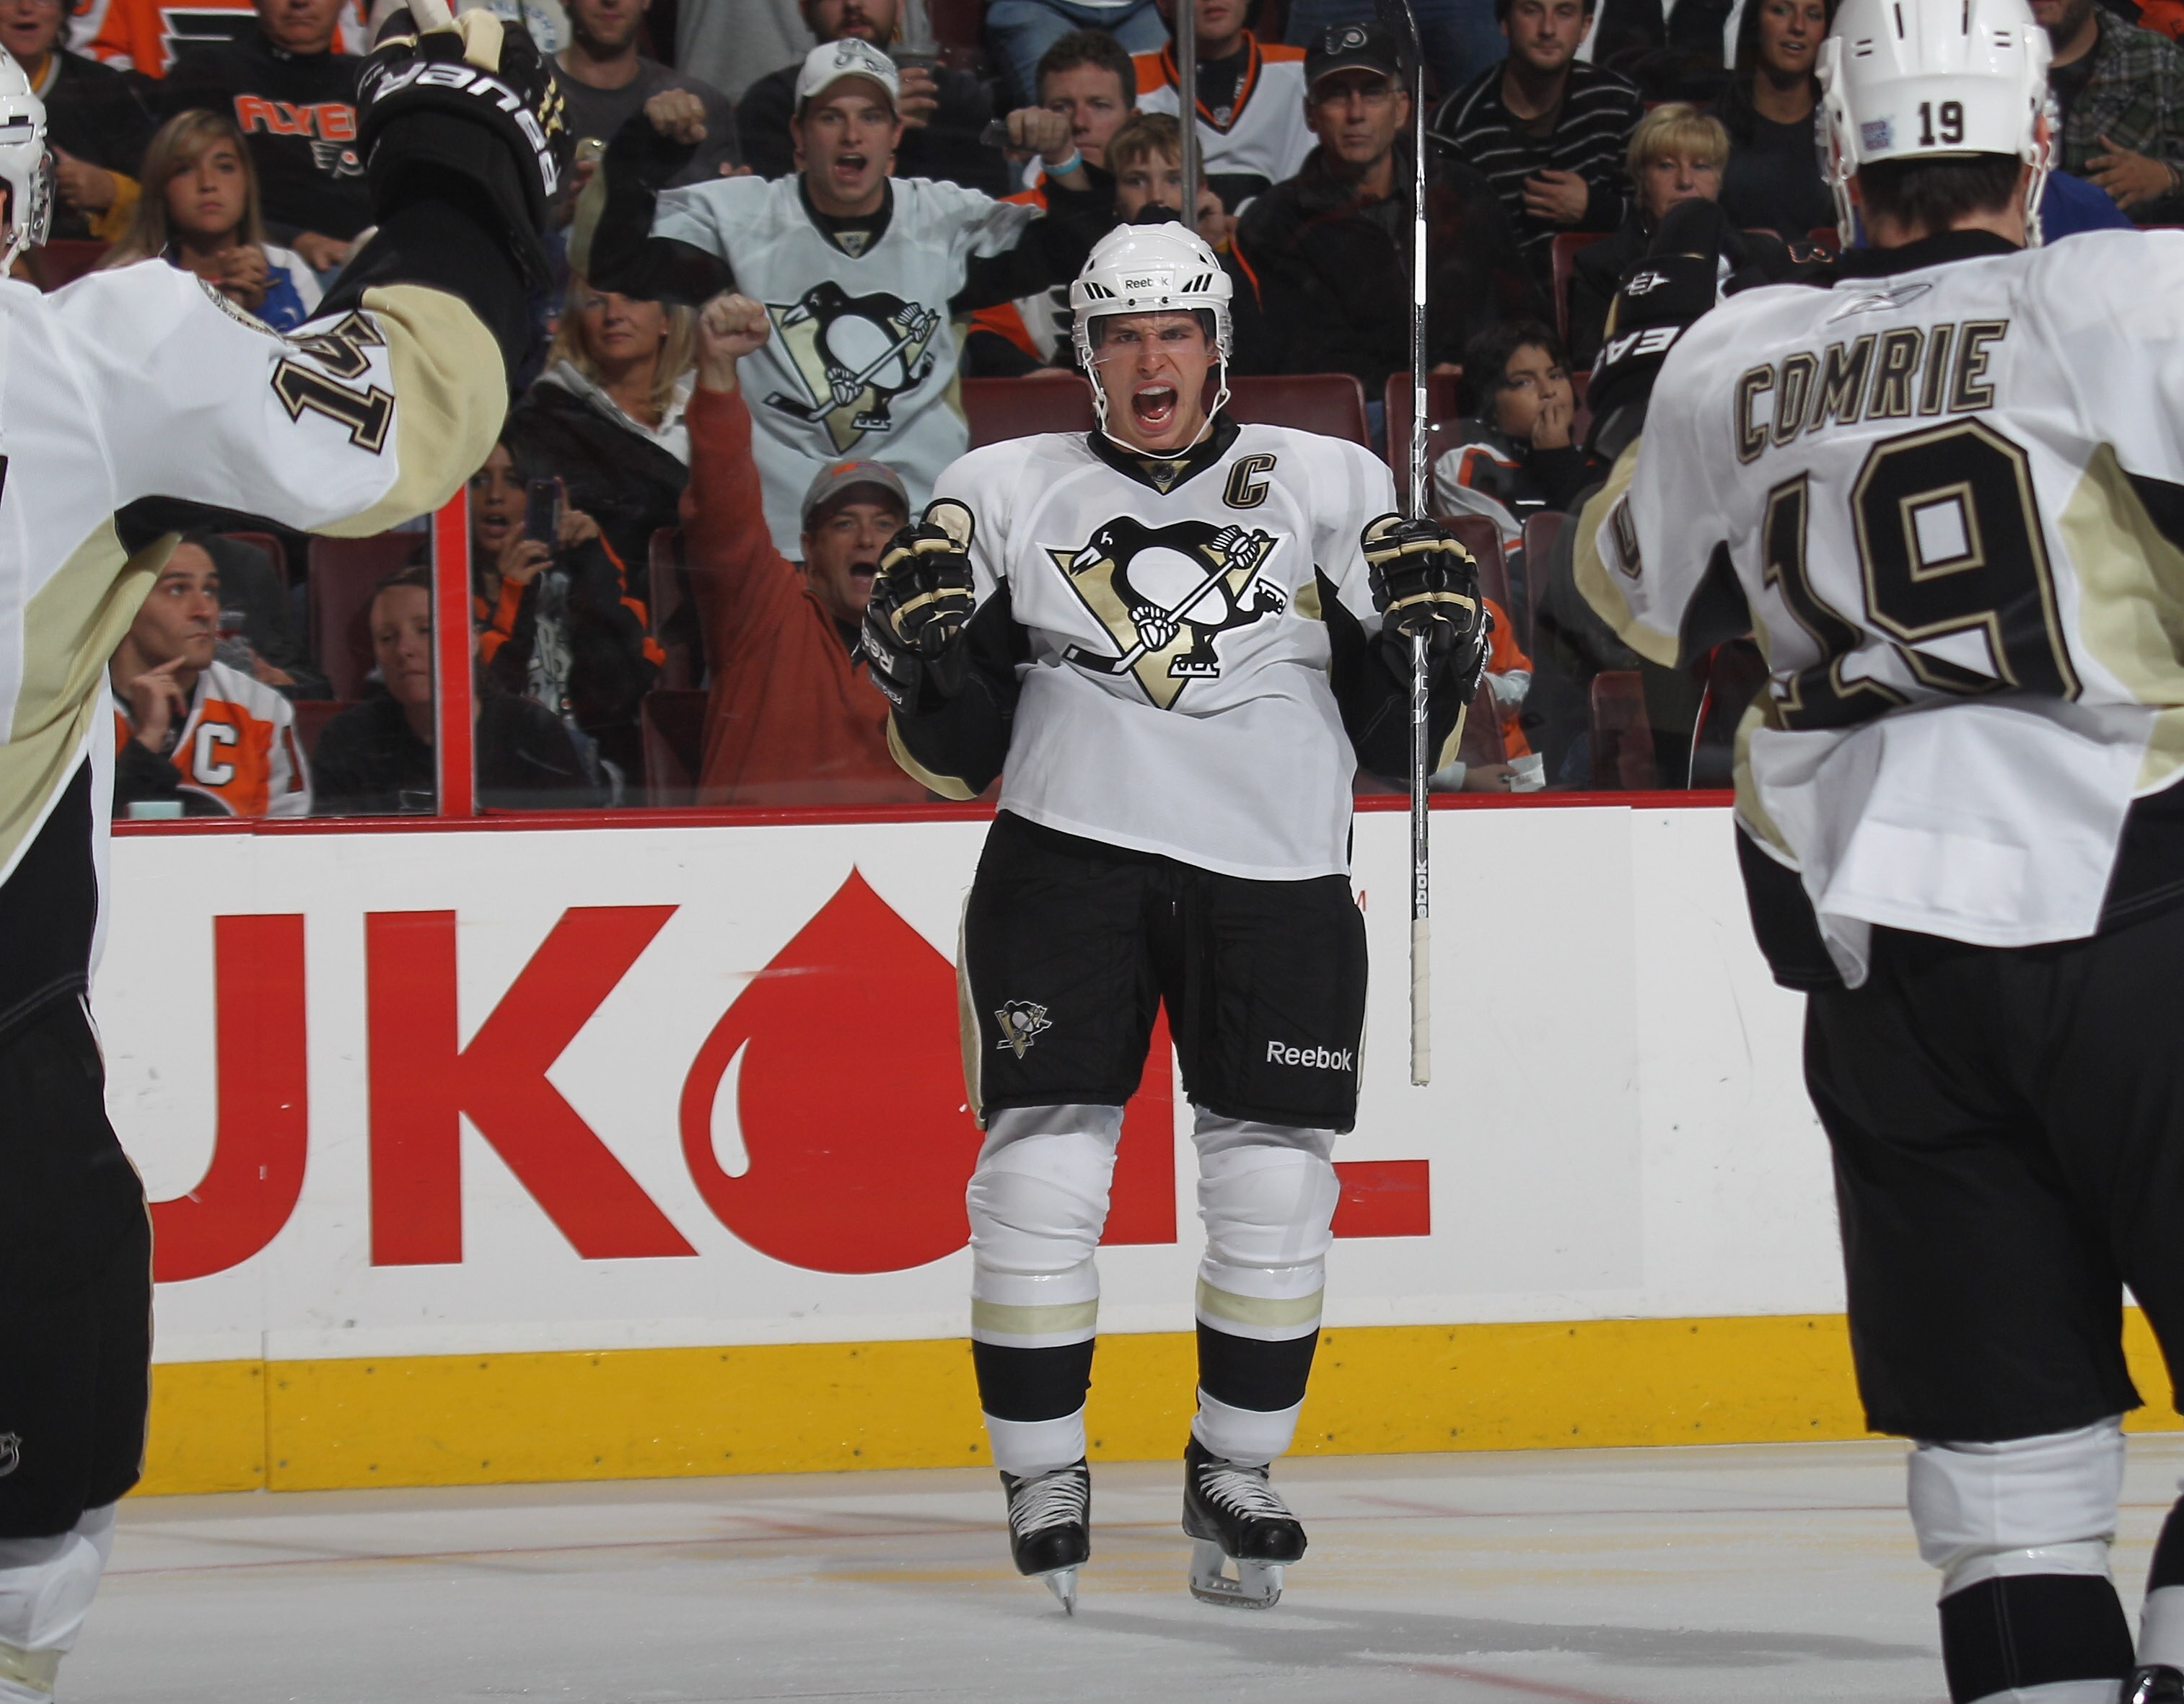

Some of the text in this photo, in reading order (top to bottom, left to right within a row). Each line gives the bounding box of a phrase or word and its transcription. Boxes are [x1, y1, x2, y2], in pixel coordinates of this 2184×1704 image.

[234, 95, 356, 141] FLYE
[1918, 101, 1965, 146] 19
[1734, 320, 2009, 466] COMRIE
[1222, 454, 1277, 509] C
[1761, 415, 2084, 731] 19
[192, 720, 240, 787] C
[1266, 1040, 1352, 1072] Reebok
